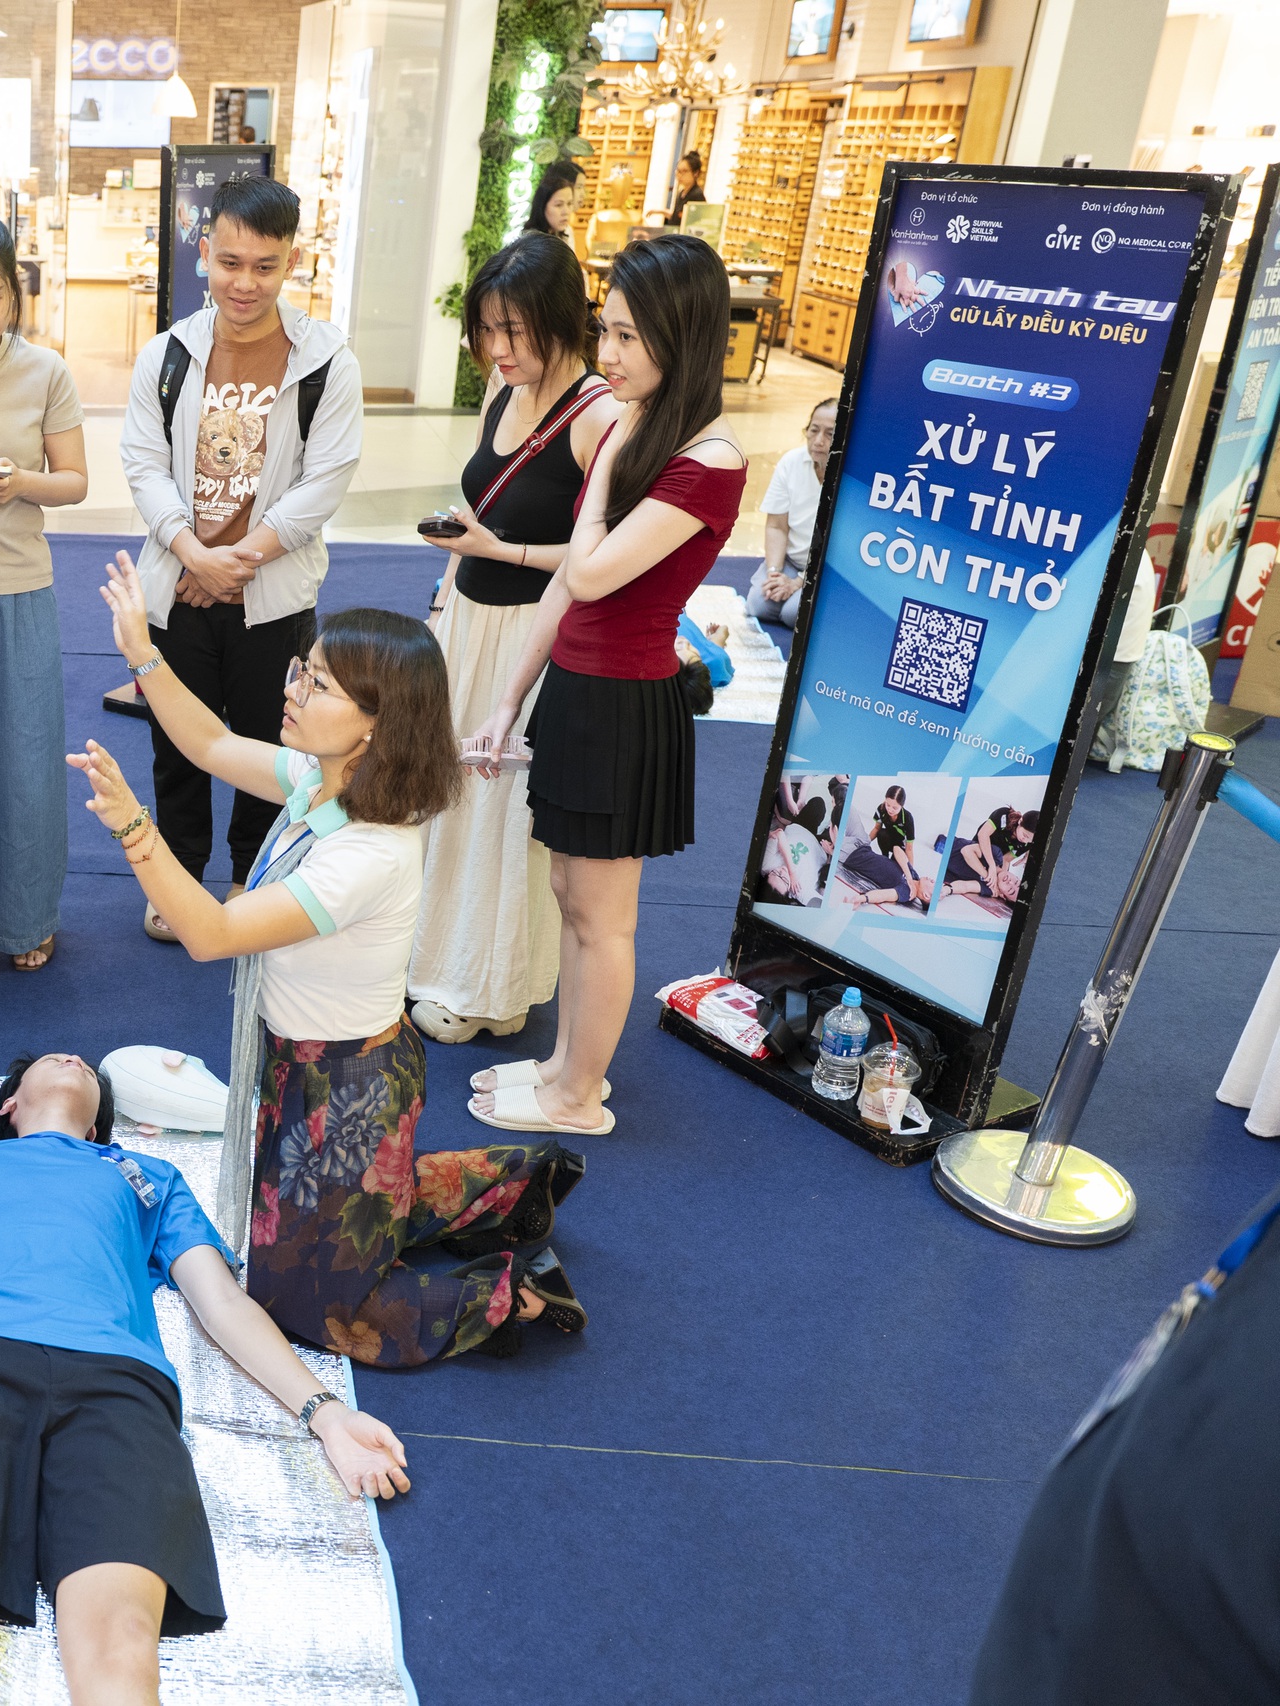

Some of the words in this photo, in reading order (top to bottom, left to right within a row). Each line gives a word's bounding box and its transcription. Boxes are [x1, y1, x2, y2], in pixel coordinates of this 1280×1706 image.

[921, 191, 937, 202] Đơn
[938, 194, 947, 204] vị
[947, 191, 957, 203] tổ
[957, 193, 979, 204] chức
[1081, 201, 1101, 212] Đơn
[1102, 203, 1112, 214] vị
[1113, 202, 1139, 216] đồng
[1139, 204, 1165, 215] hành
[970, 234, 999, 243] VIETNAM
[971, 227, 994, 235] SKILLS
[972, 219, 1004, 229] SURVIVAL
[1118, 237, 1131, 246] NQ
[1131, 238, 1166, 248] MEDICAL
[955, 278, 1082, 308] Nhanh
[1092, 290, 1178, 322] tay
[950, 305, 981, 324] GIỮ
[982, 304, 1017, 329] LẤY
[1020, 309, 1065, 334] ĐIỀU
[1068, 316, 1096, 337] KỲ
[1099, 322, 1148, 345] DIỆU
[929, 367, 1024, 394] Booth
[1028, 381, 1072, 402] #3
[916, 413, 988, 465] XỬ
[992, 430, 1056, 479] LÝ
[869, 463, 955, 522] BẤT
[968, 485, 1083, 552] TỈNH
[859, 527, 951, 585] CÒN
[964, 559, 1068, 611] THỞ
[815, 680, 847, 703] Quét
[849, 691, 871, 711] mã
[873, 699, 896, 720] QR
[897, 705, 919, 727] để
[919, 718, 950, 739] xem
[953, 726, 1001, 759] hướng
[1004, 744, 1036, 767] dẫn
